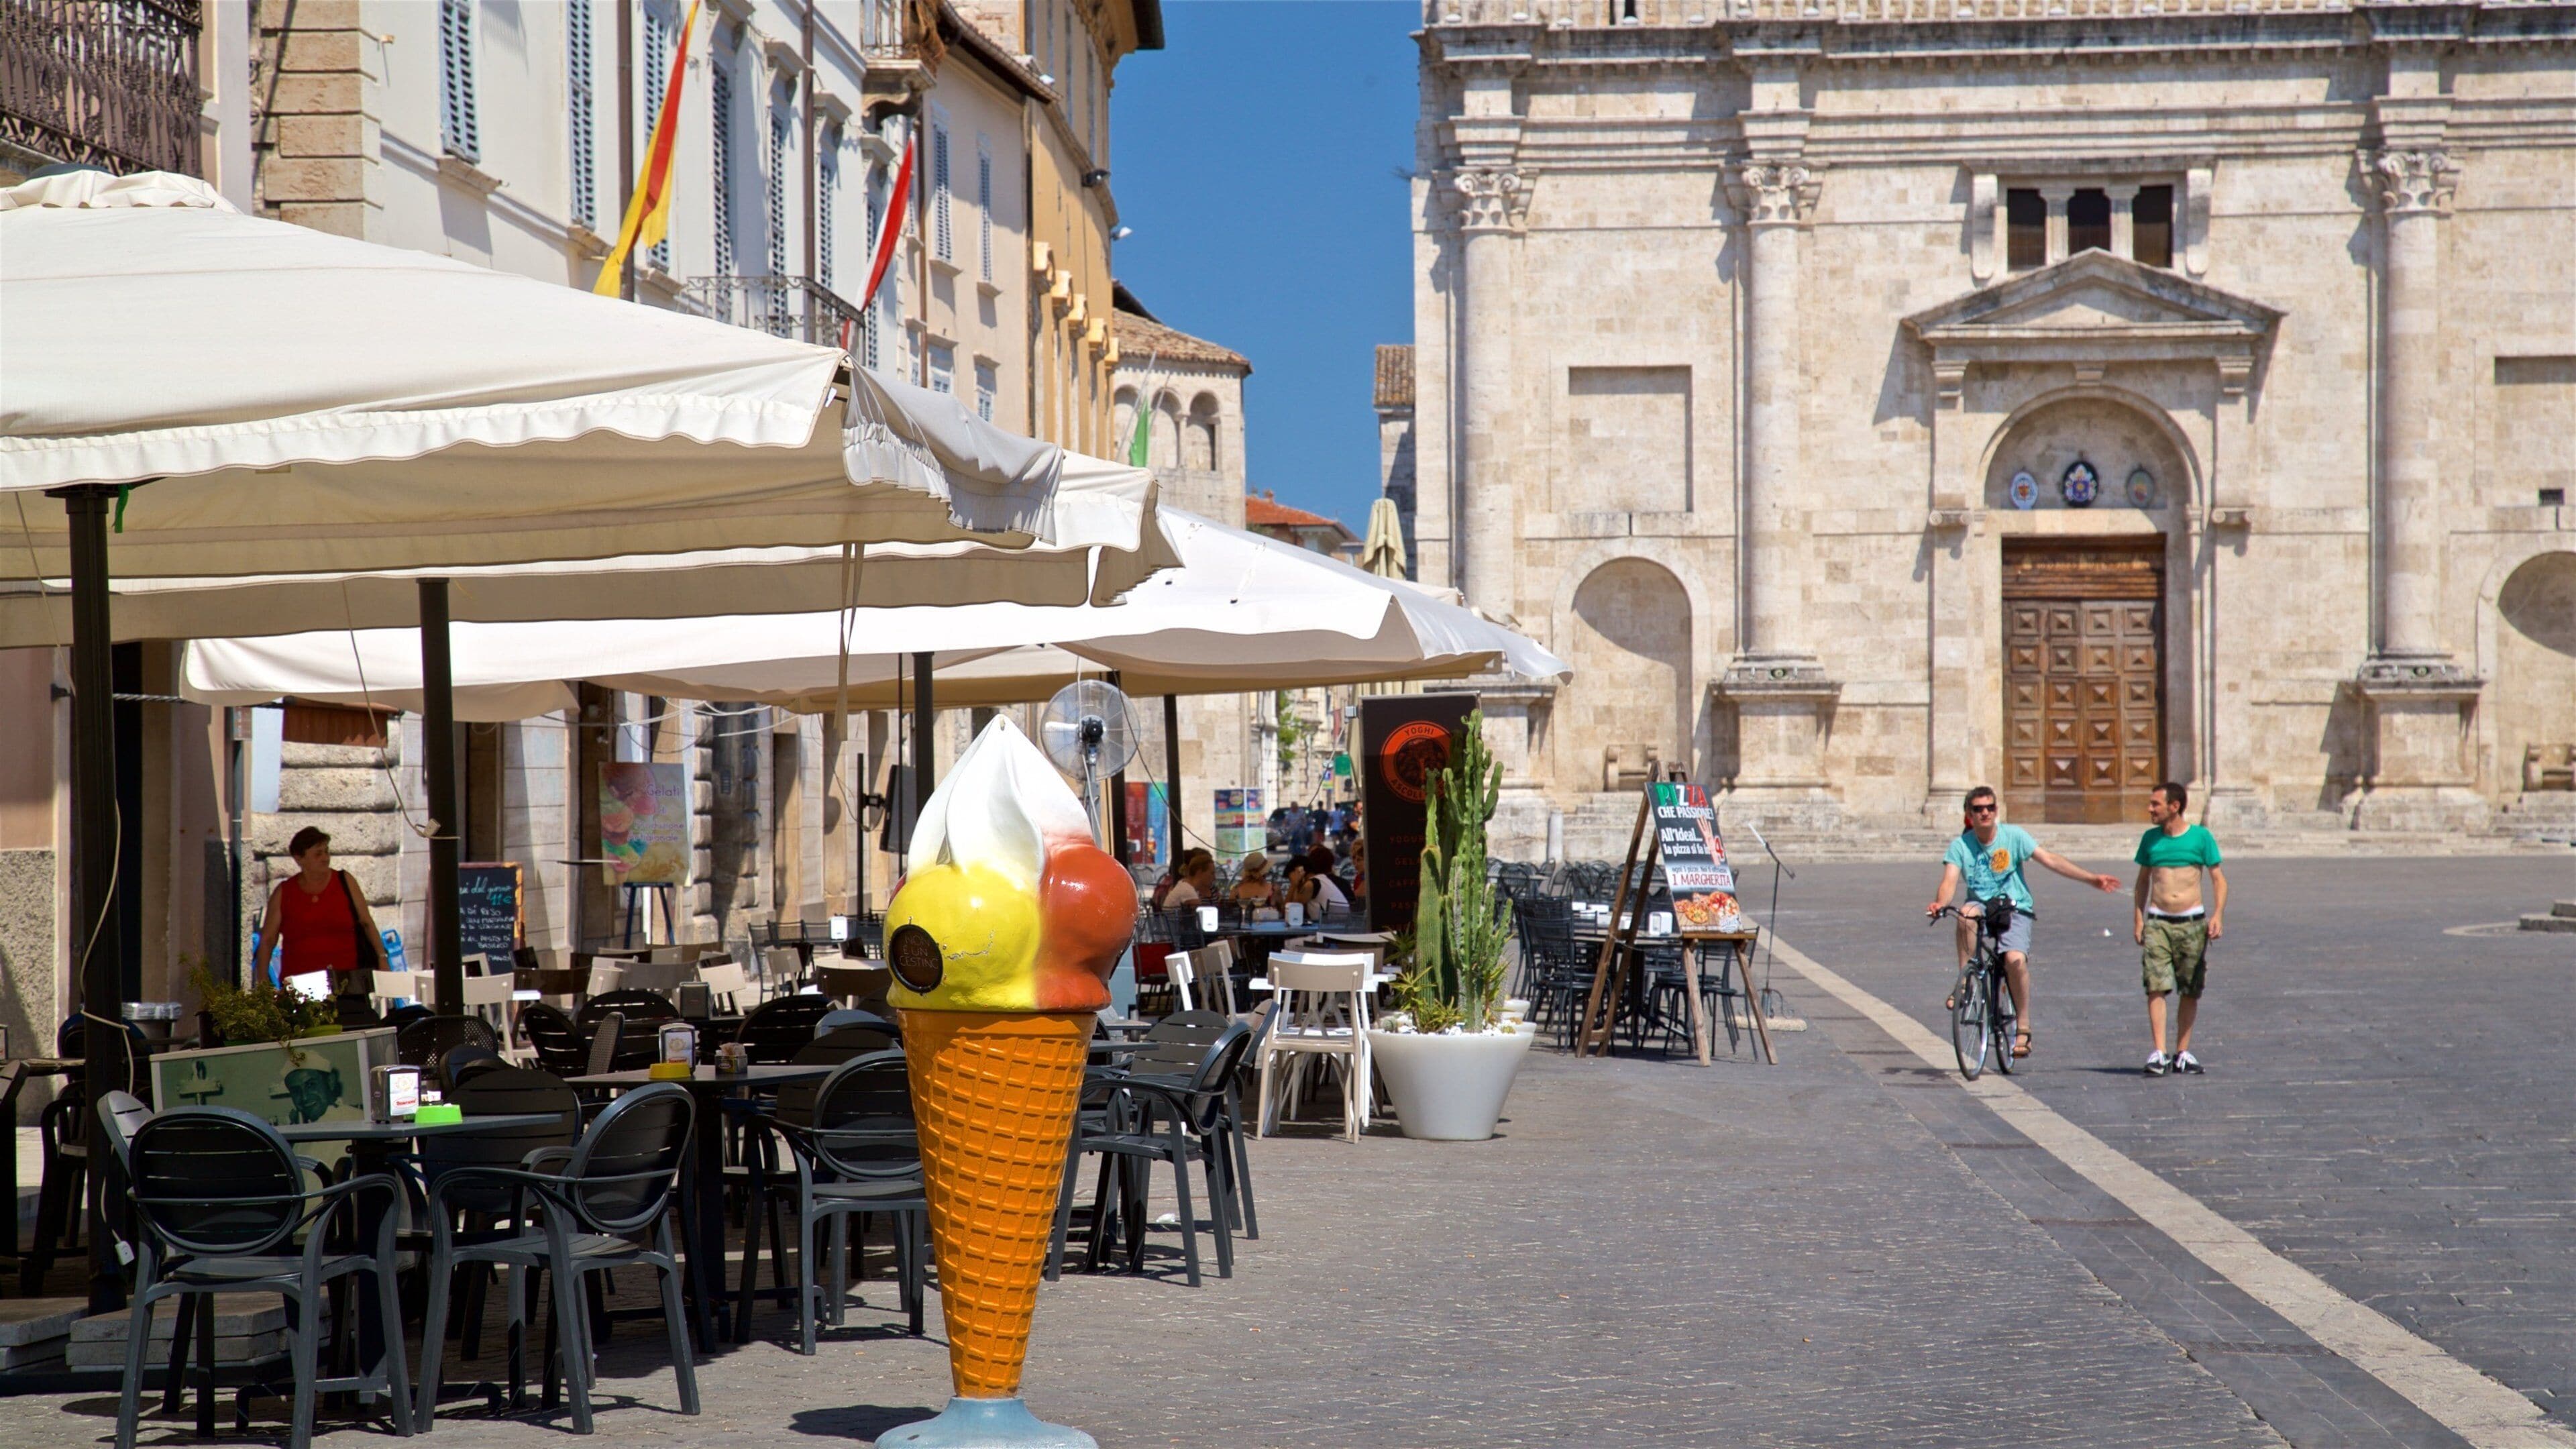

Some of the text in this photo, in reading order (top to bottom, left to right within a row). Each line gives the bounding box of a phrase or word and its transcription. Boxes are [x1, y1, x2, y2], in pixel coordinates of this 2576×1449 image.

[1405, 727, 1434, 736] YOGHI
[647, 784, 680, 796] Gelati
[1391, 779, 1422, 798] ASCOLI
[1655, 784, 1709, 807] PIZZA
[1658, 806, 1715, 819] CHE PASSIONE!
[1672, 843, 1690, 857] pizza
[1690, 843, 1697, 854] si
[1697, 843, 1704, 854] fa
[1715, 836, 1725, 862] 4
[1672, 873, 1731, 886] 1 MARGHERITA
